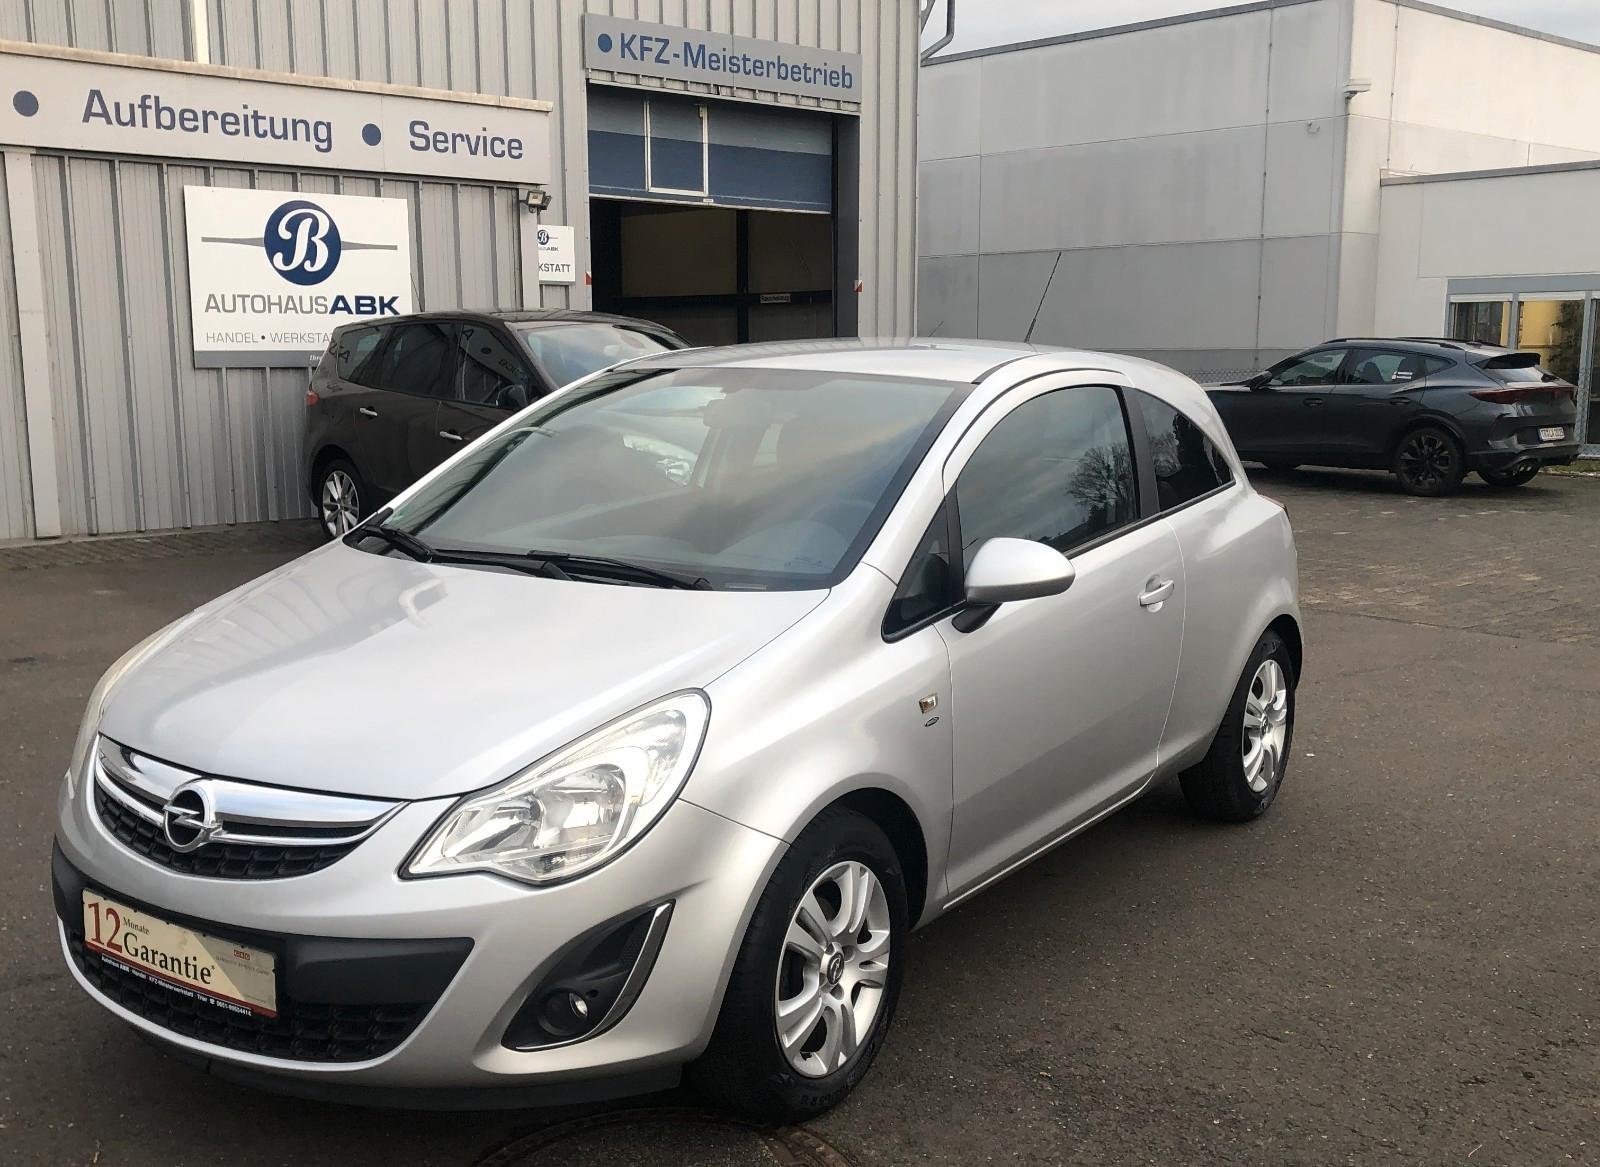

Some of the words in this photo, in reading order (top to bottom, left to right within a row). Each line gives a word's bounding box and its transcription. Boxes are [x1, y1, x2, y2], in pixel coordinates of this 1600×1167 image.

[620, 32, 853, 89] KFZ-Meisterbetrieb
[82, 88, 333, 153] Aufbereitung
[408, 119, 524, 160] Service
[206, 332, 258, 344] HANDEL
[88, 902, 123, 954] 12
[123, 916, 150, 936] Monate
